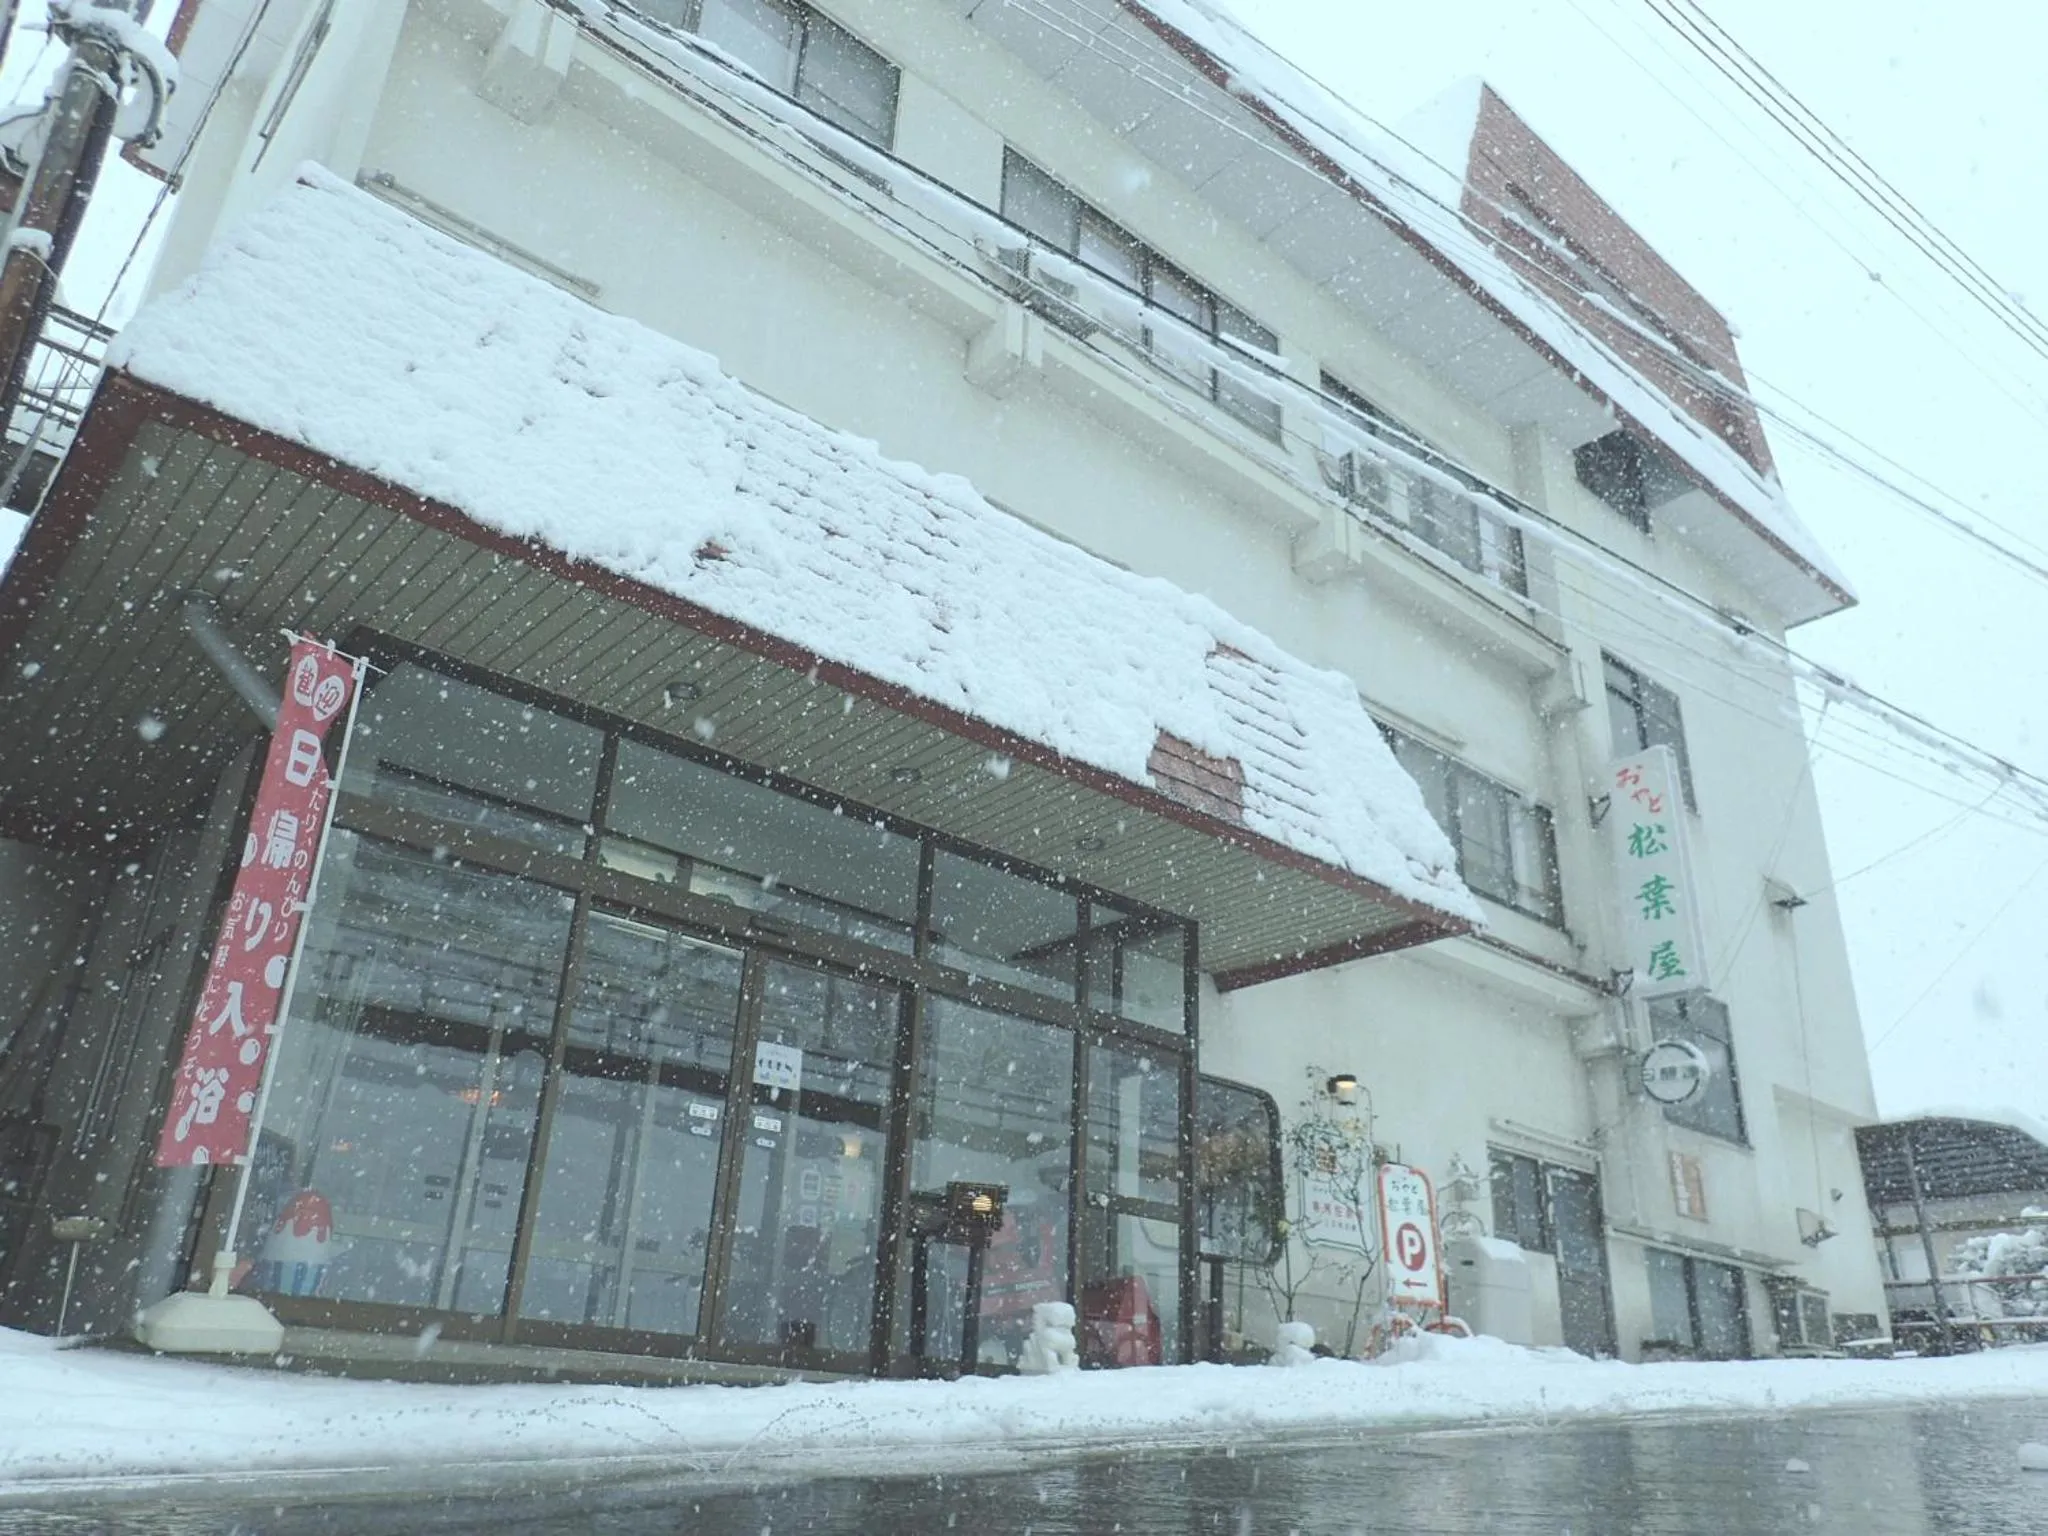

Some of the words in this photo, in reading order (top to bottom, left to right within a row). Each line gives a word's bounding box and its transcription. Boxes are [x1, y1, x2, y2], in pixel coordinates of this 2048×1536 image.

[296, 662, 342, 716] 歓迎
[1616, 764, 1662, 814] おやど
[273, 767, 329, 944] ったり、のんびり
[1628, 822, 1687, 982] 松葉屋
[175, 729, 321, 1142] 日帰り入浴
[1402, 1228, 1424, 1267] P
